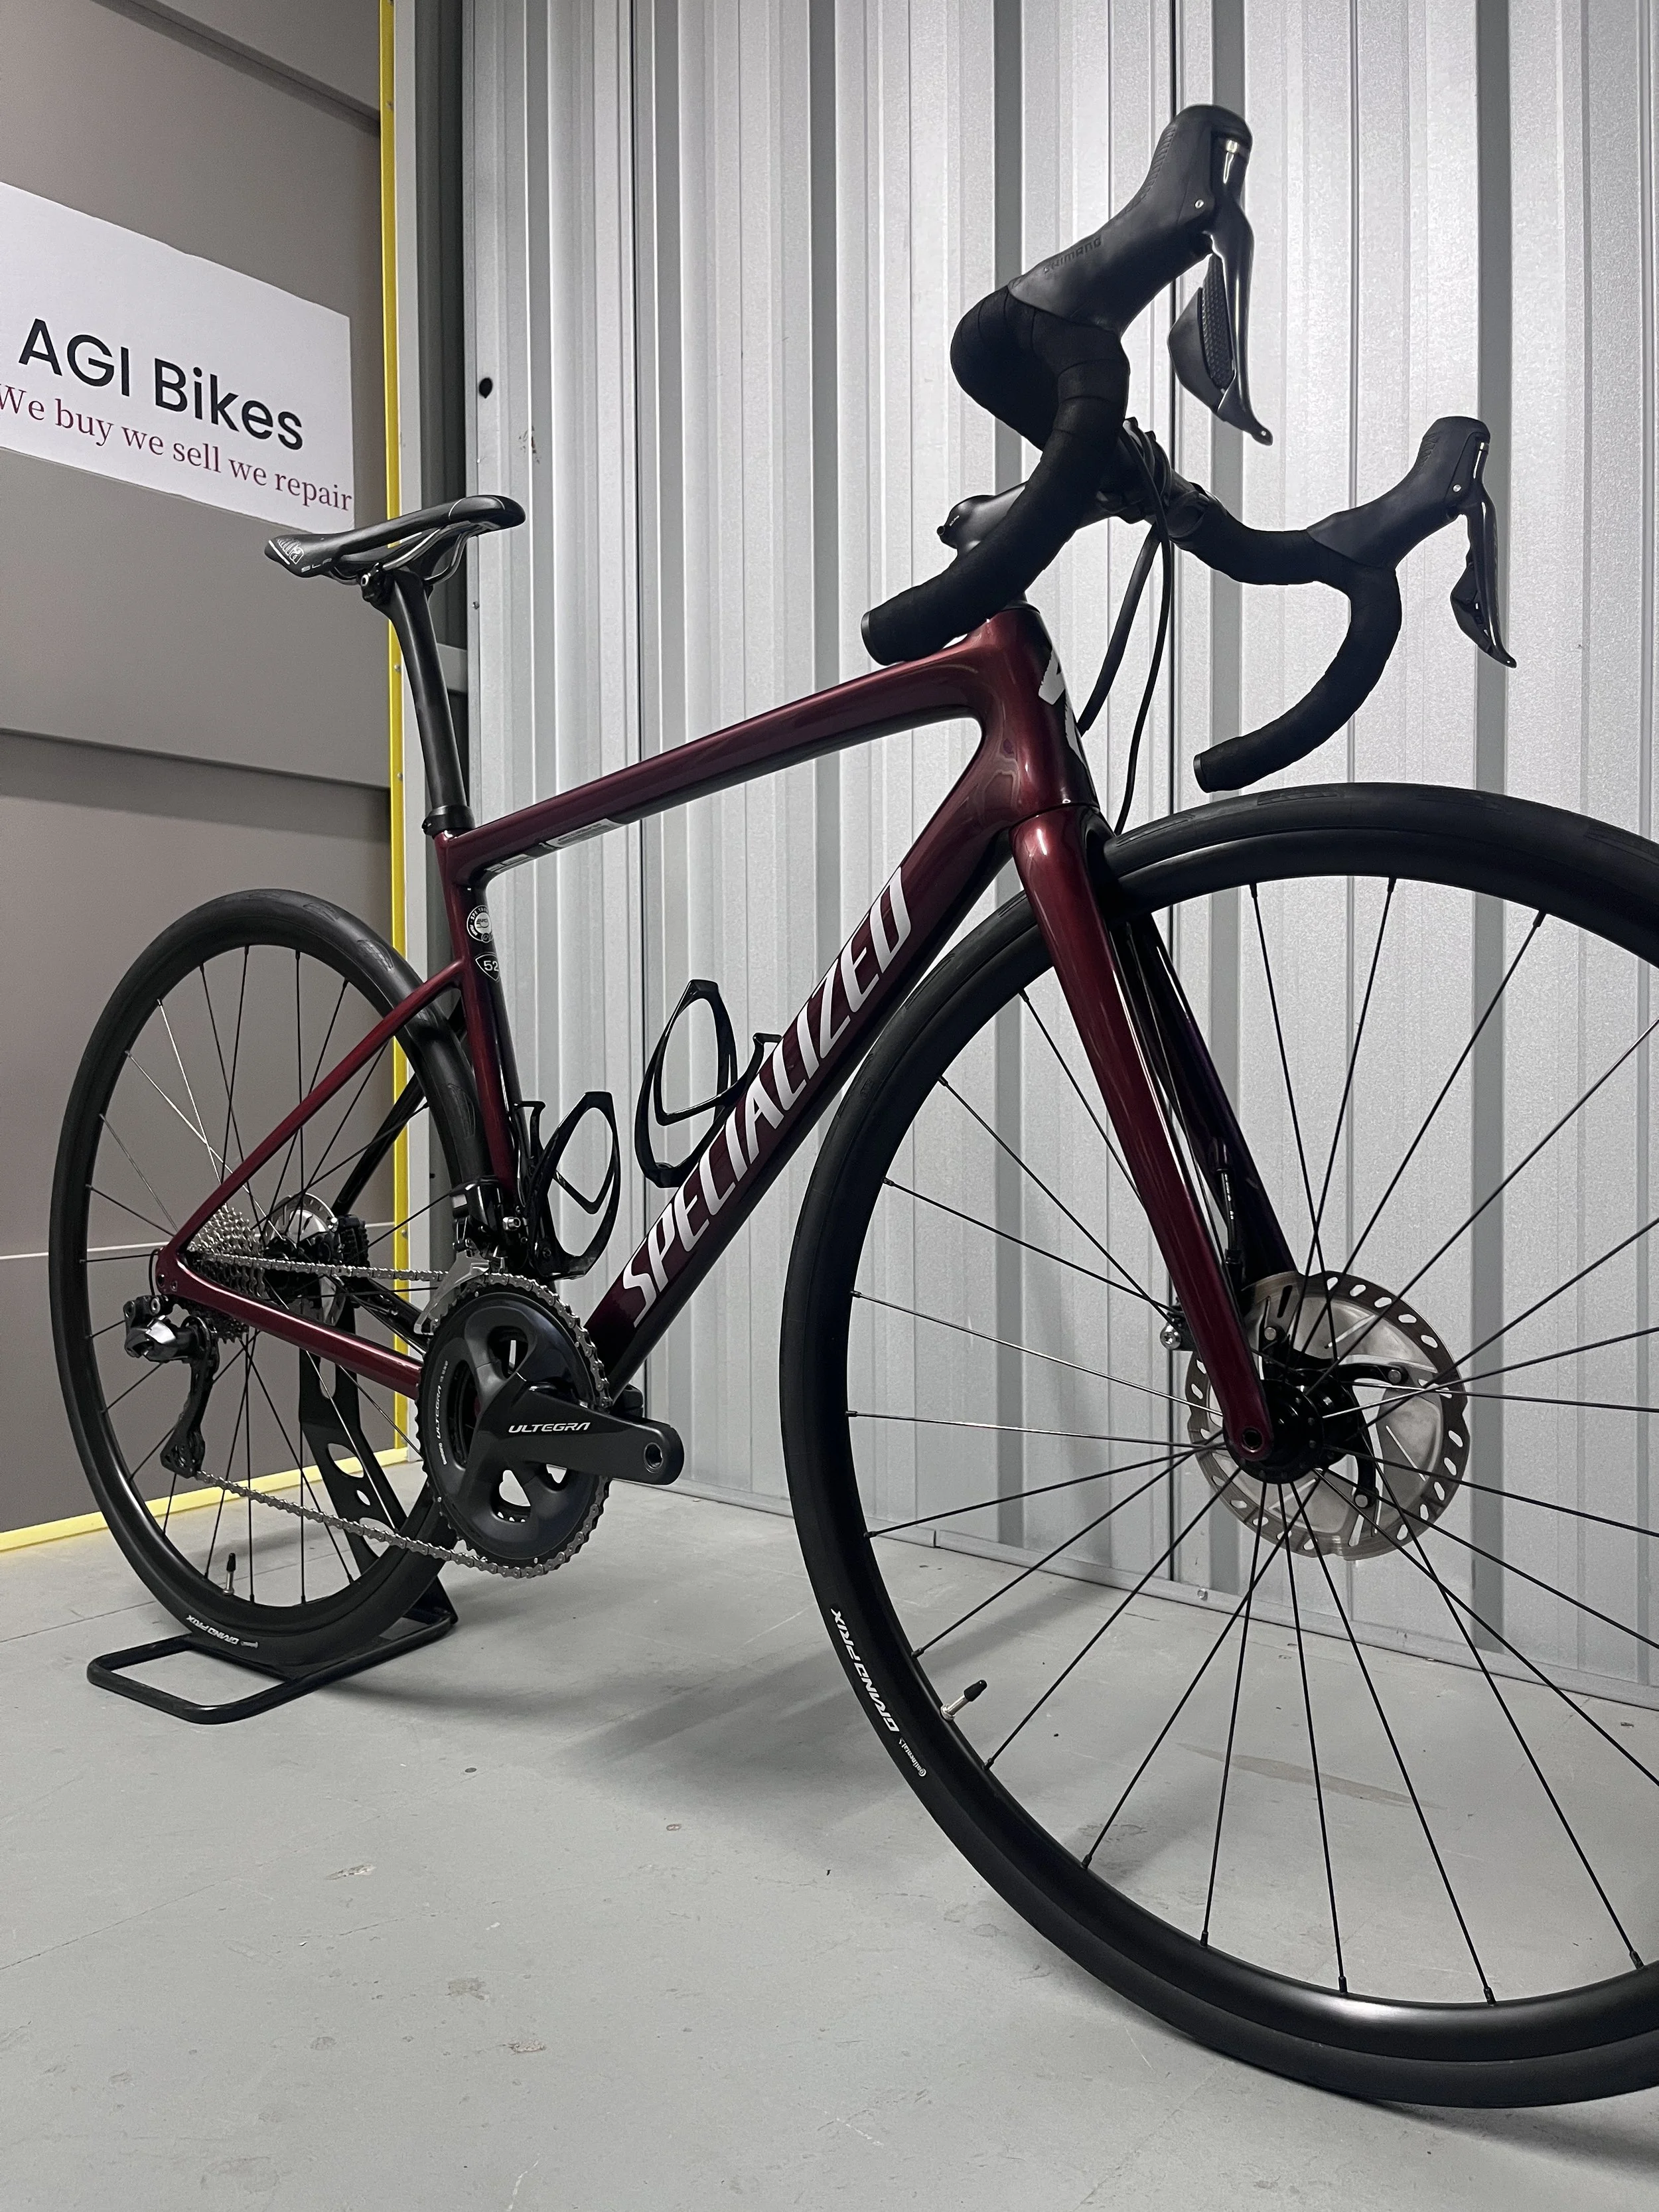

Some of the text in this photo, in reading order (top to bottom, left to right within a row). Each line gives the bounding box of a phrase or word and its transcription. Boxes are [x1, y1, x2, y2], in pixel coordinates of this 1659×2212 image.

[19, 319, 303, 451] AGI Bikes
[0, 384, 352, 511] We buy we sell we repair
[483, 960, 499, 972] 52
[622, 867, 911, 1327] SPECIALIZED
[508, 1422, 591, 1433] ULTEGRA
[186, 1615, 240, 1645] GRAND PRIX
[831, 1608, 900, 1732] GRAND PRIX
[901, 1742, 926, 1777] Continental
